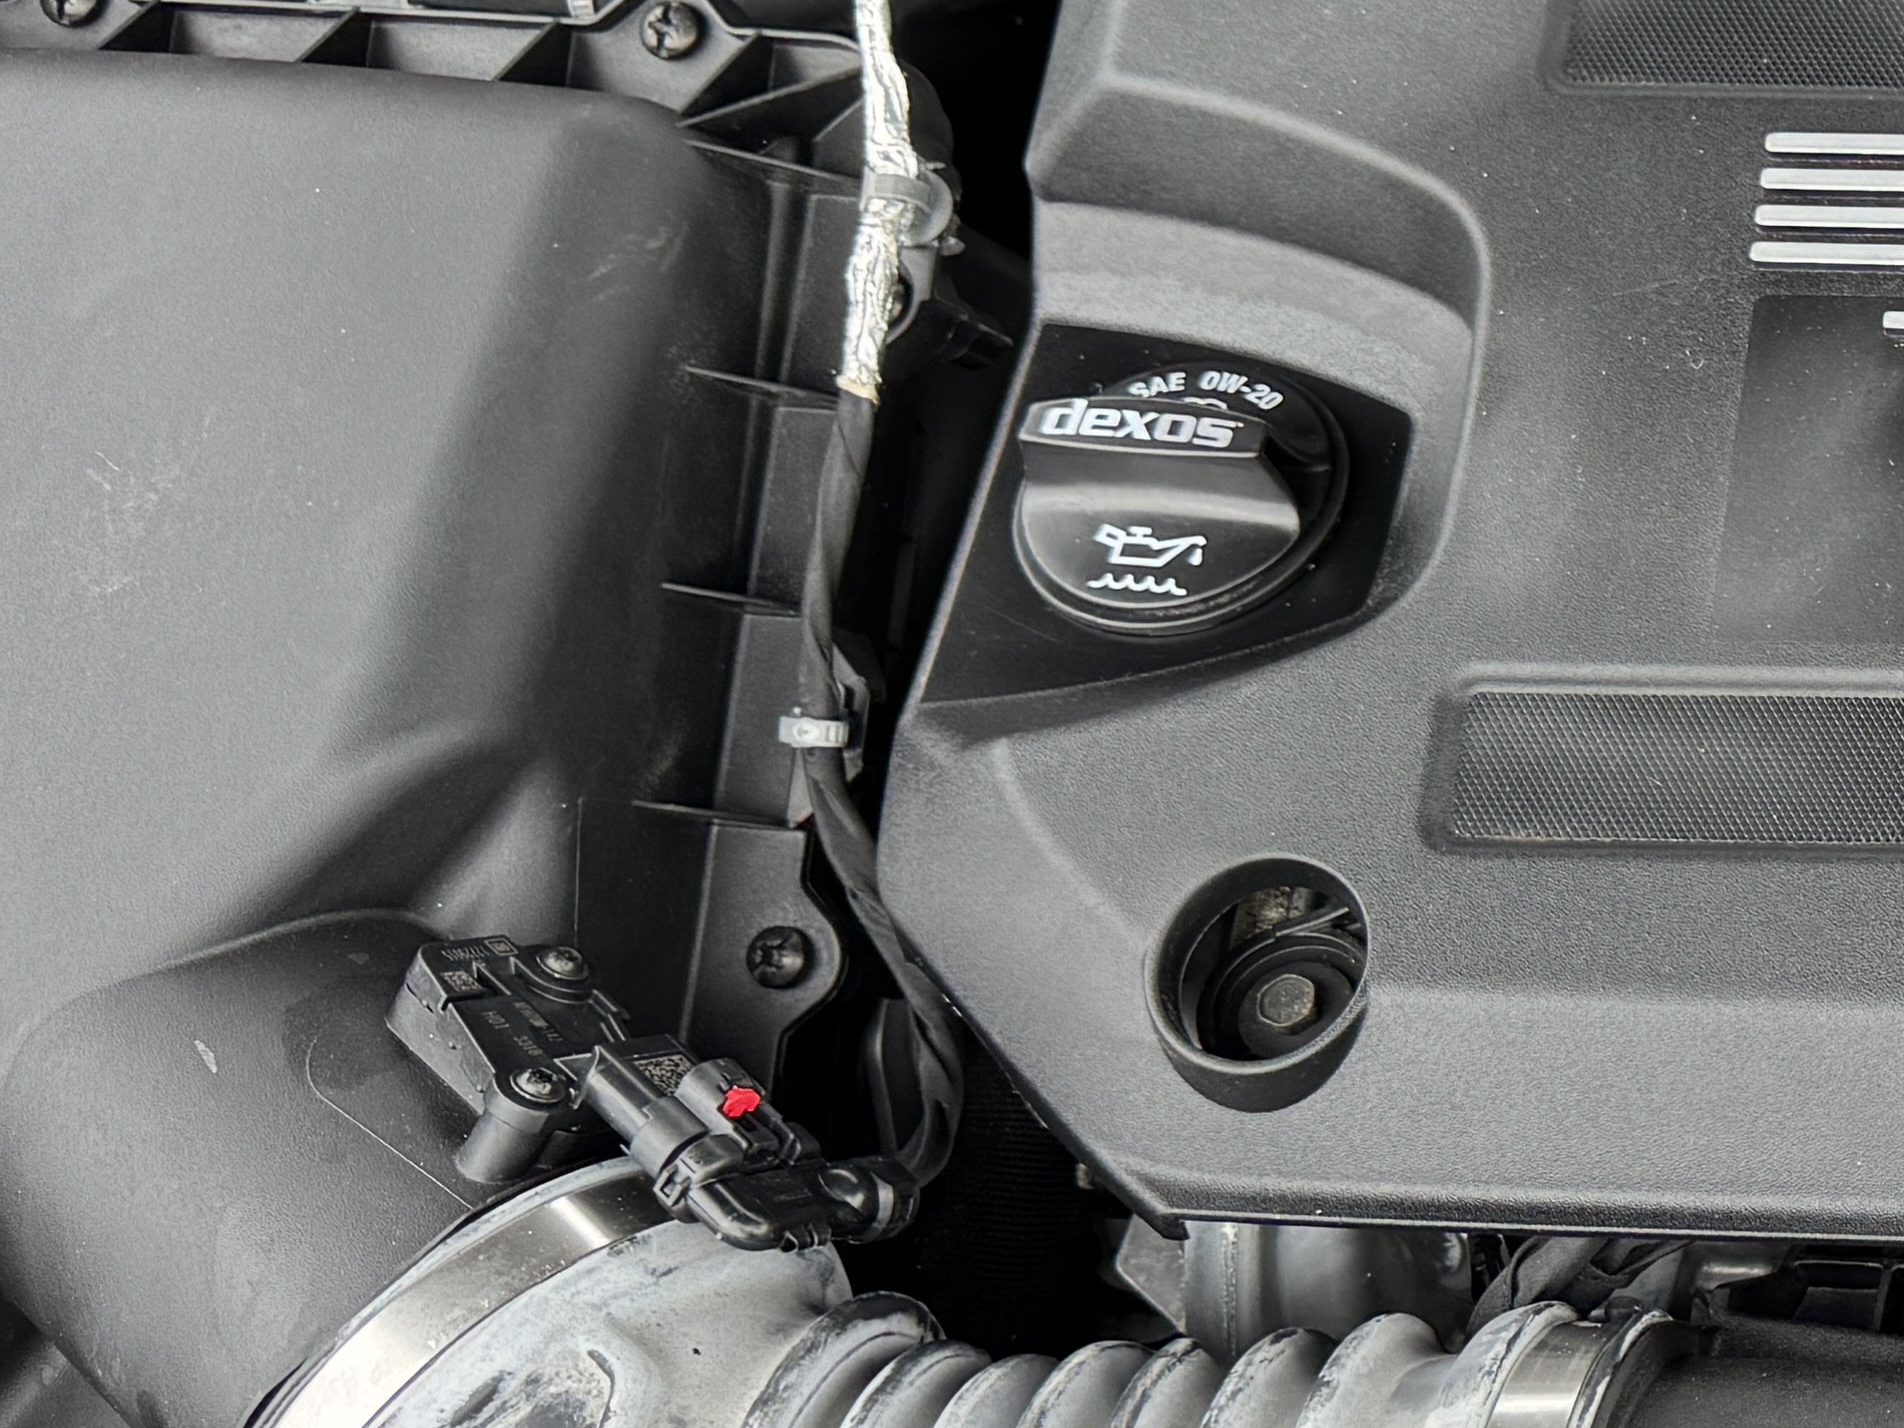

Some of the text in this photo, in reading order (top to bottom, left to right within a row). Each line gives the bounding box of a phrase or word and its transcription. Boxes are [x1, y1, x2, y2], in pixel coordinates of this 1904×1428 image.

[1128, 370, 1285, 411] SAE 0W-20
[1039, 398, 1237, 448] dexos
